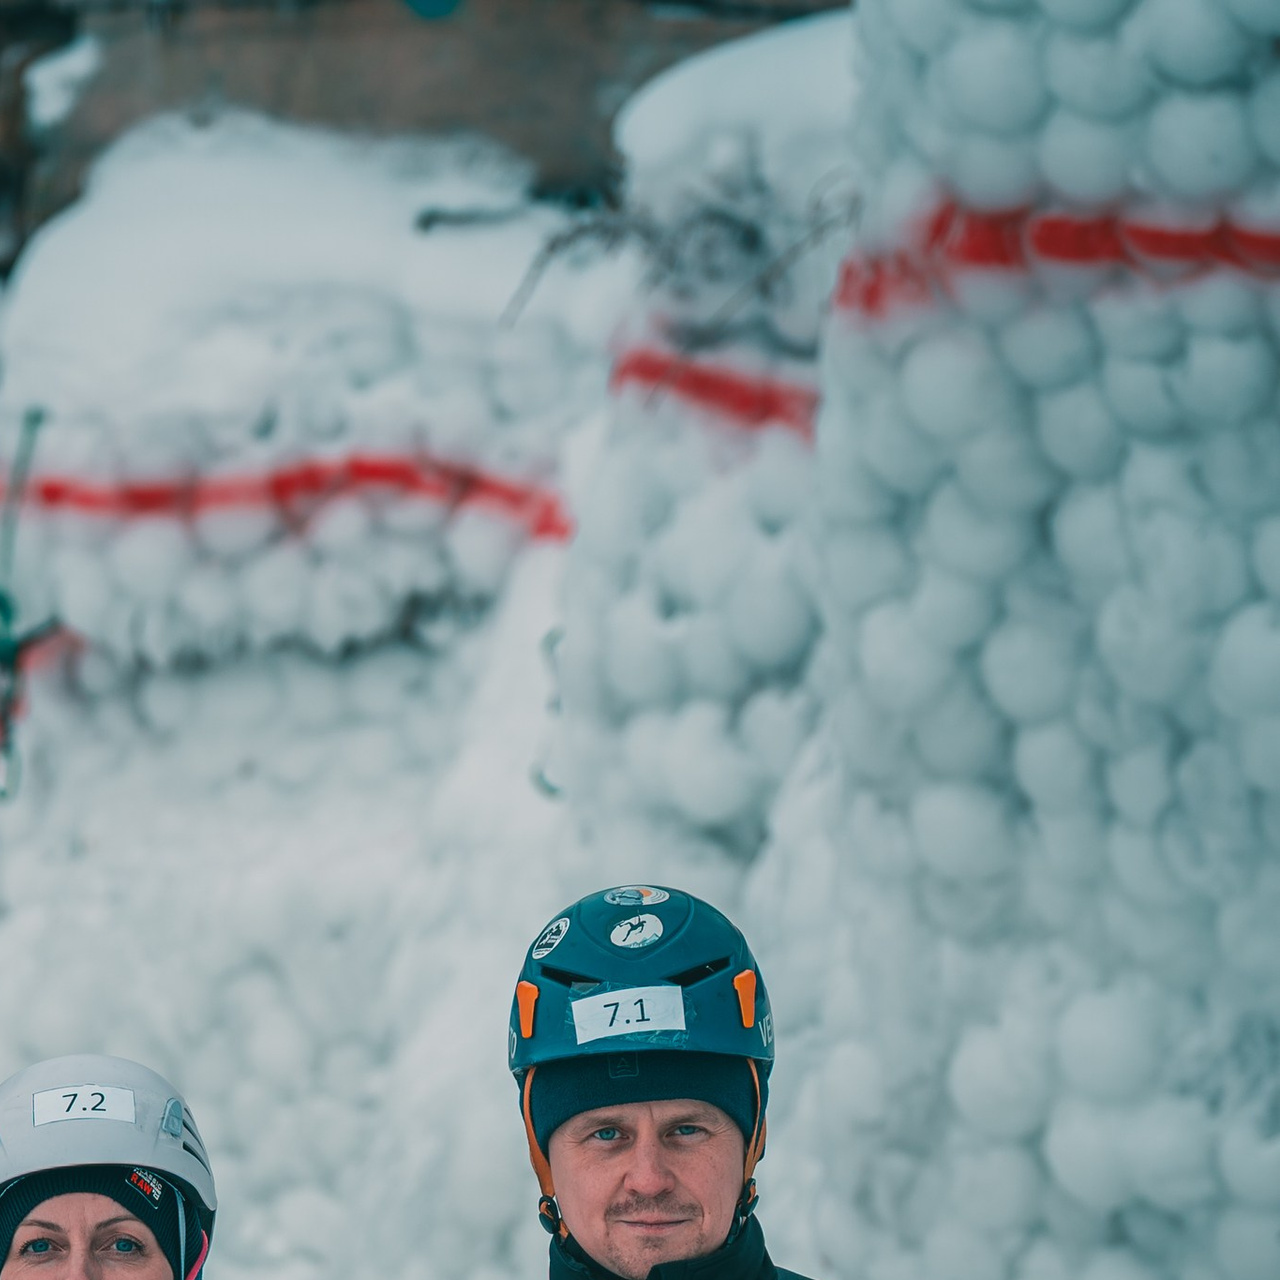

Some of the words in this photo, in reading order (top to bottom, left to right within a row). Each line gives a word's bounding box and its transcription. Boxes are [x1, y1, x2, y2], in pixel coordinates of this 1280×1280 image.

[603, 998, 651, 1027] 7.1
[62, 1092, 107, 1113] 7.2
[131, 1173, 153, 1195] RAW
